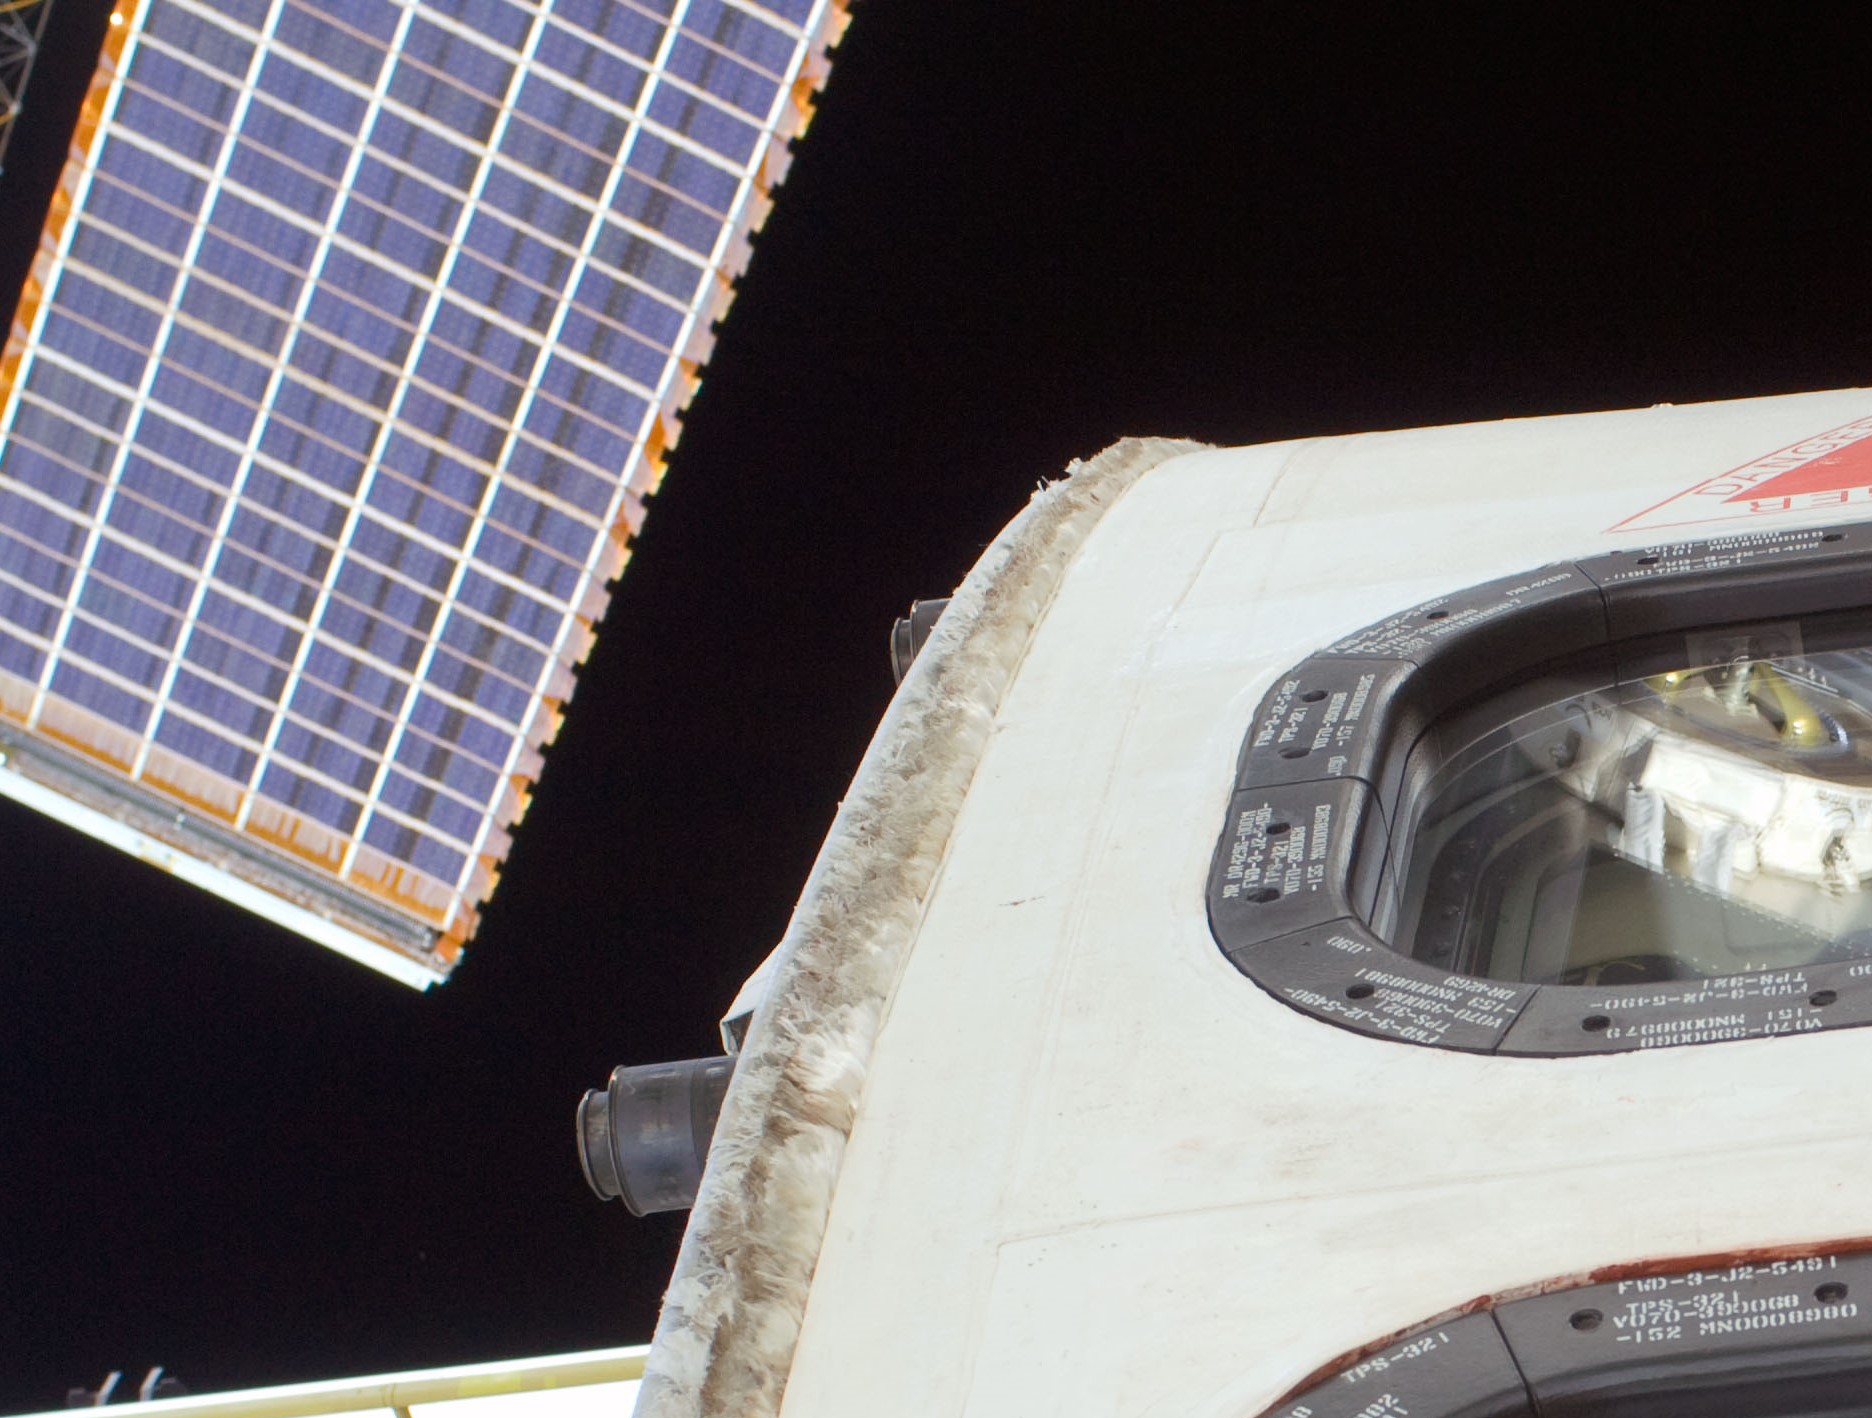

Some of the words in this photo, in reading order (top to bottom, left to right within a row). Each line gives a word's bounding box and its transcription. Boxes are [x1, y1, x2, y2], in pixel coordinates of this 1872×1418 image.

[1612, 1293, 1801, 1330] V070-390068
[1615, 1325, 1683, 1344] -152
[1699, 1303, 1859, 1337] MN0008980
[1625, 1290, 1741, 1318] TPS-321
[1339, 1331, 1450, 1383] TPS-321
